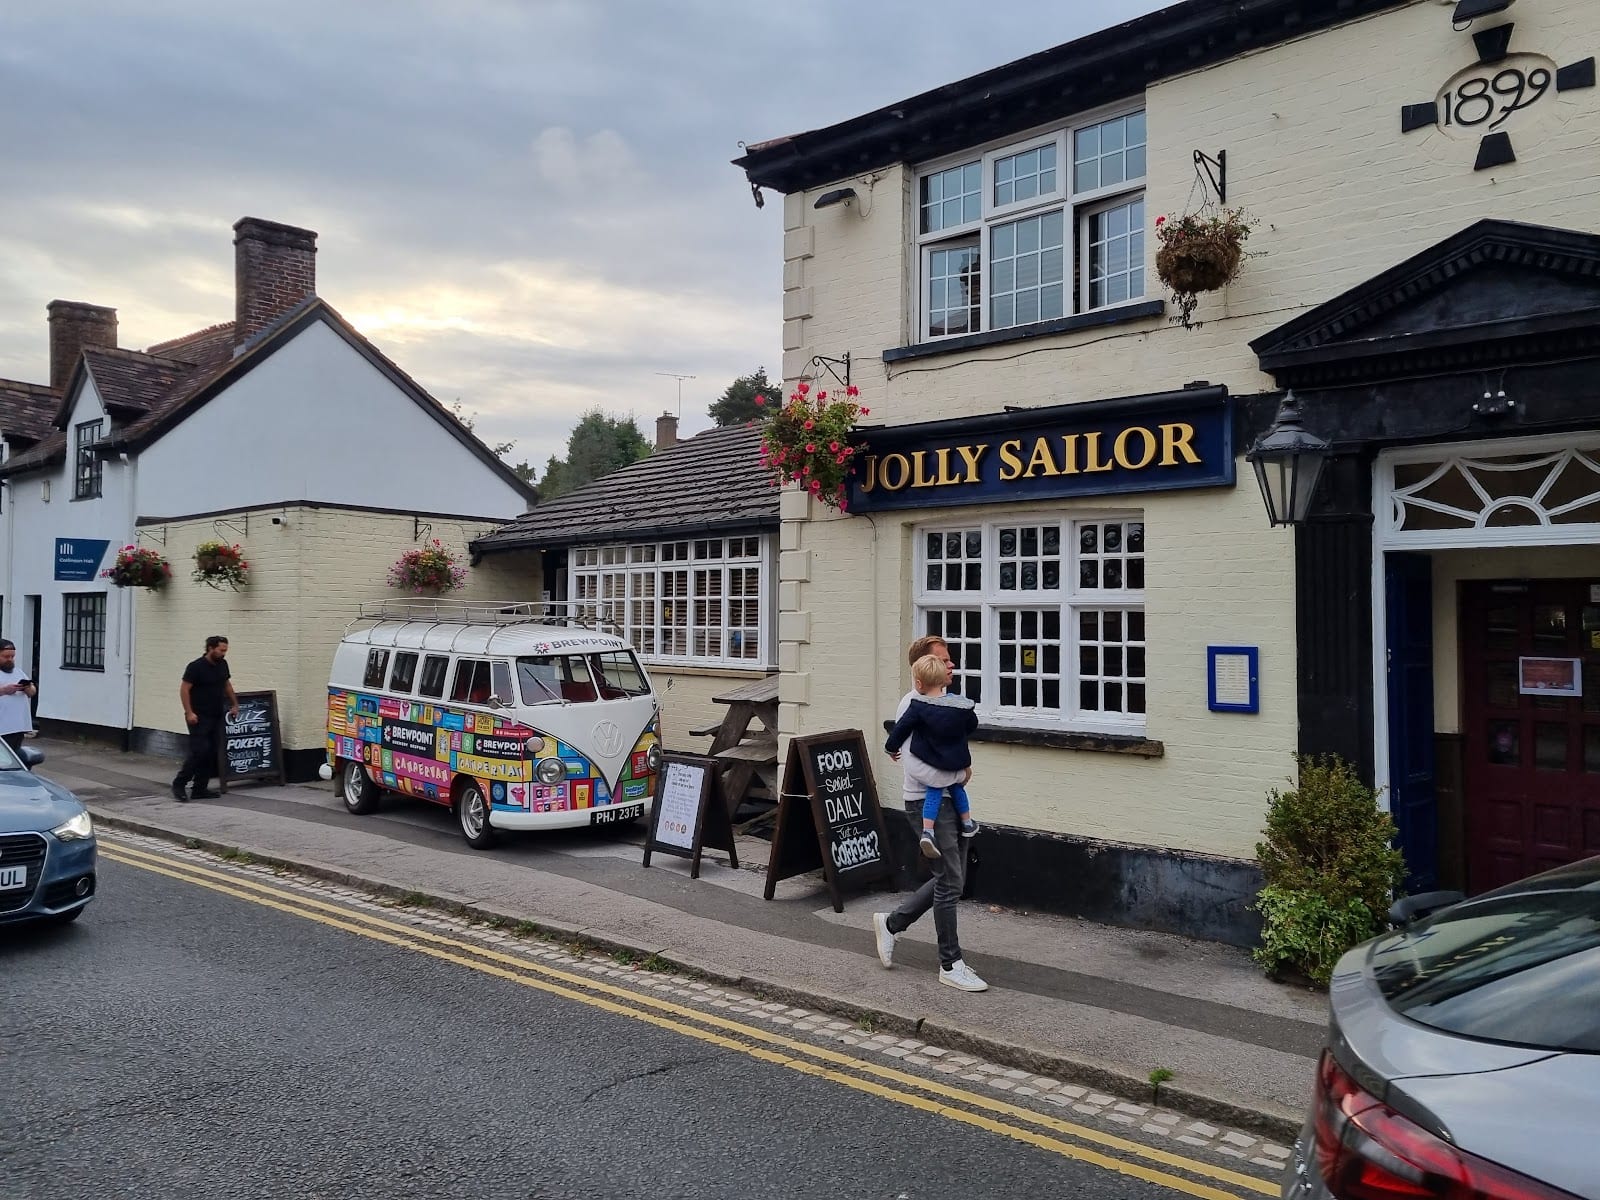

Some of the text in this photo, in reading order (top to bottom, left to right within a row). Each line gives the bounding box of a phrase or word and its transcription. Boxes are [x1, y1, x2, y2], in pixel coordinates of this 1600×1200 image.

[1443, 68, 1551, 132] 1899
[860, 422, 1202, 493] JOLLY SAILOR
[550, 637, 624, 650] BREWPOINT
[225, 724, 248, 735] NIGHT
[392, 726, 434, 745] BREWPOINT
[226, 736, 263, 750] POKER
[394, 757, 449, 782] CAMPERVAN
[459, 758, 525, 777] CAMPERVAN
[817, 750, 853, 774] FOOD
[596, 805, 640, 824] PHJ 237E
[825, 792, 863, 823] DAILY
[1, 870, 23, 887] UL
